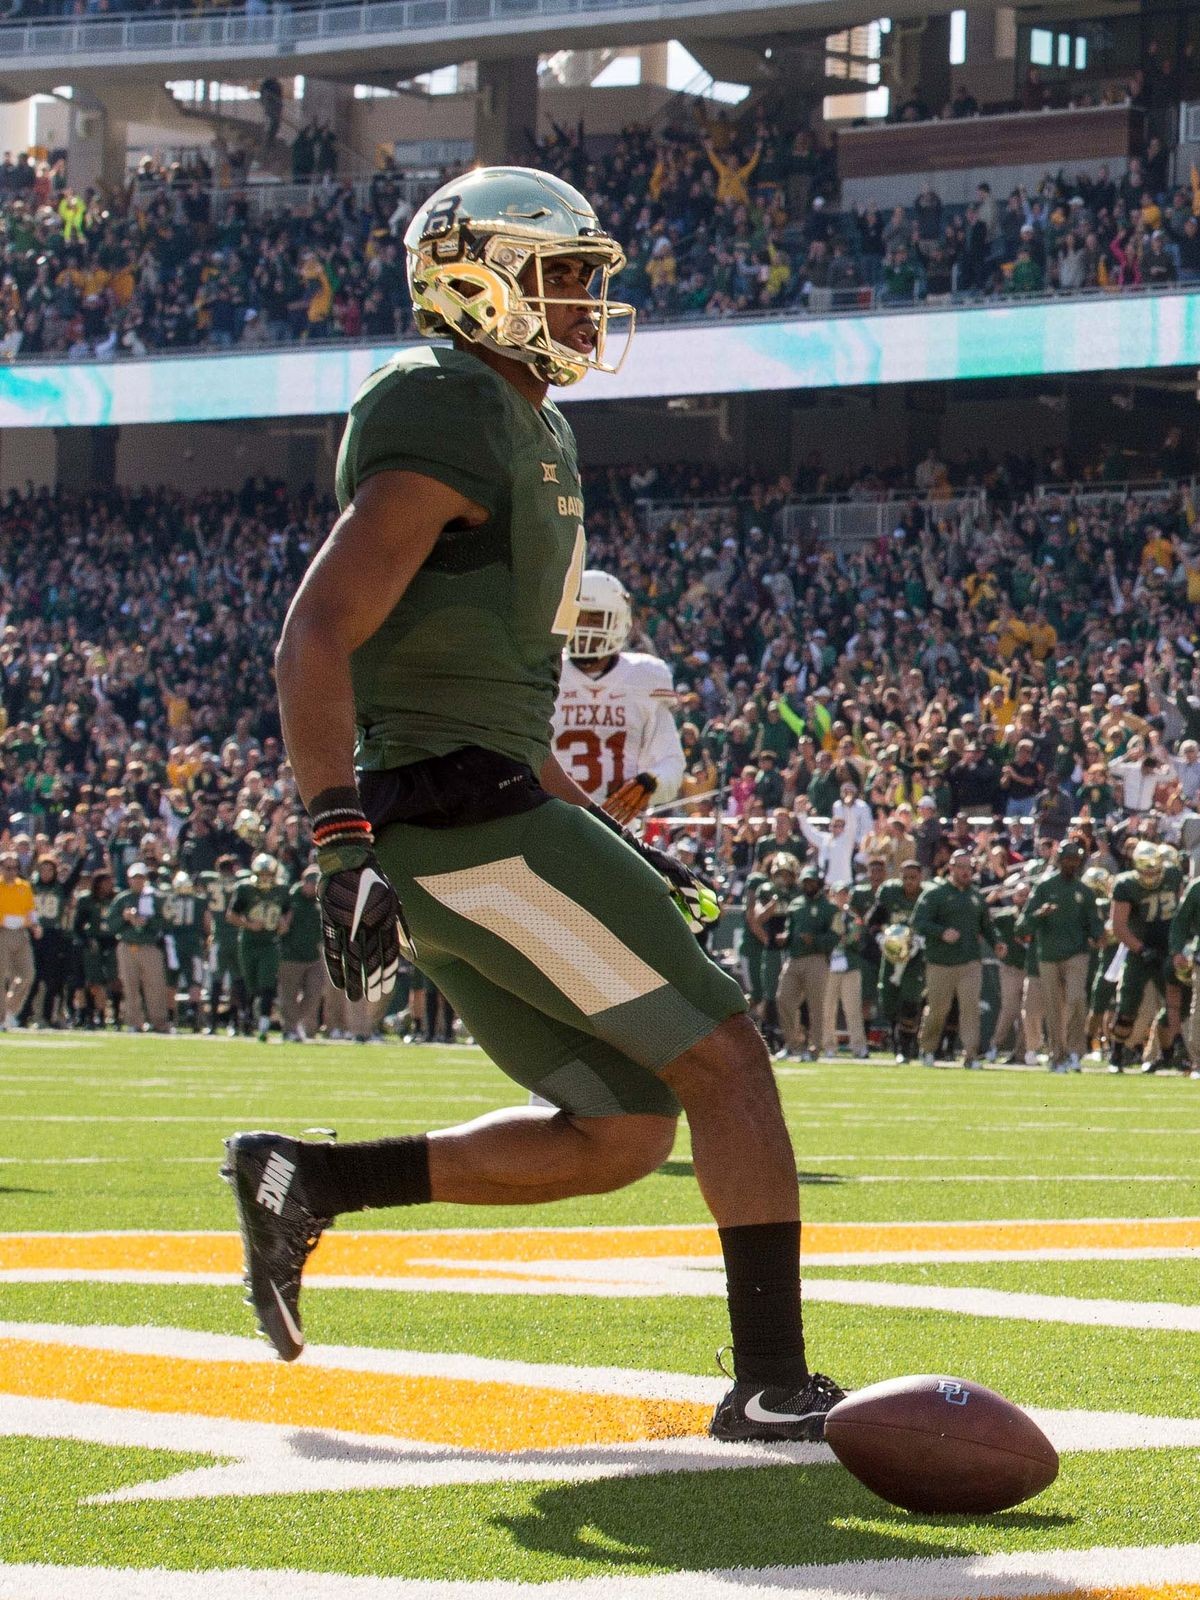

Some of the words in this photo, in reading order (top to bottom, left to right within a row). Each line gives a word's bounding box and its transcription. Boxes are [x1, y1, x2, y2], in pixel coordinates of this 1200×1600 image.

[562, 705, 626, 727] TEXAS
[556, 729, 627, 797] 31
[255, 1150, 297, 1217] NIKE
